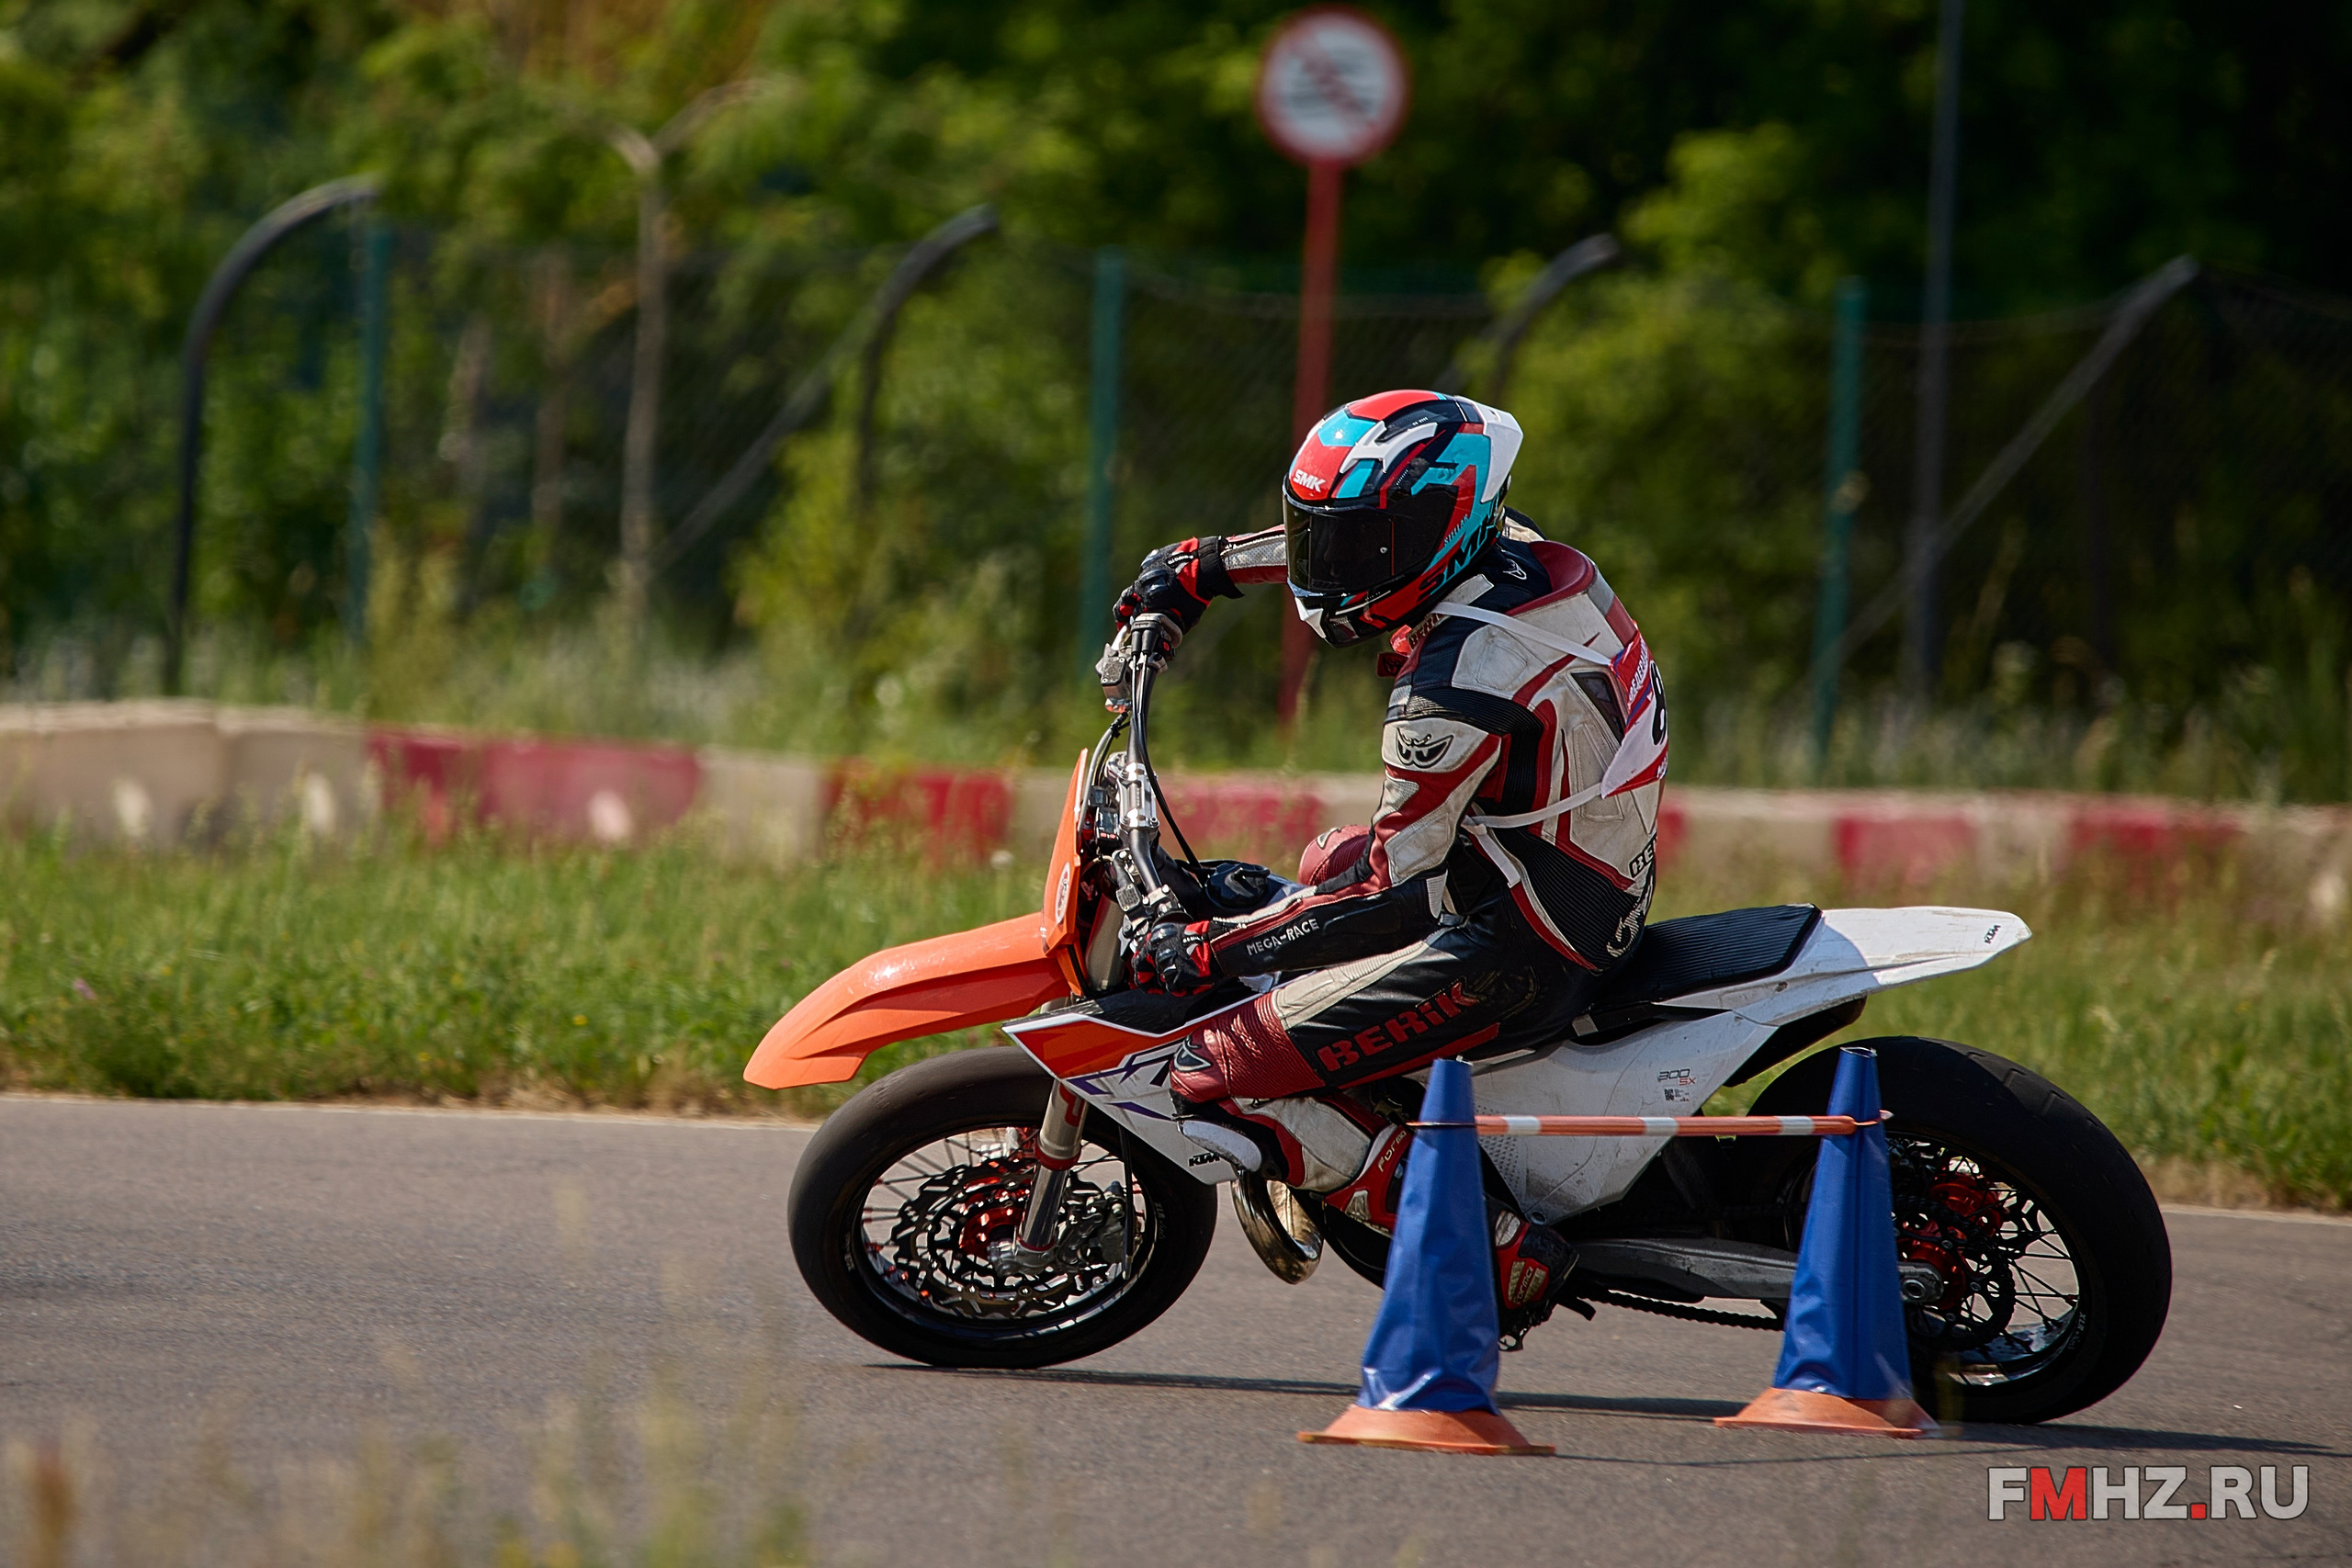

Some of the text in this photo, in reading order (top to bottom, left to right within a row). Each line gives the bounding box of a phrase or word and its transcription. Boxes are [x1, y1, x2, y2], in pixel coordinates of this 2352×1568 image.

[1293, 468, 1327, 493] SMK
[1246, 919, 1320, 956] MEGA-RACE
[1984, 924, 2001, 944] KTM
[1657, 1068, 1690, 1081] 300
[1679, 1077, 1696, 1087] SX
[1189, 1152, 1221, 1167] KTM
